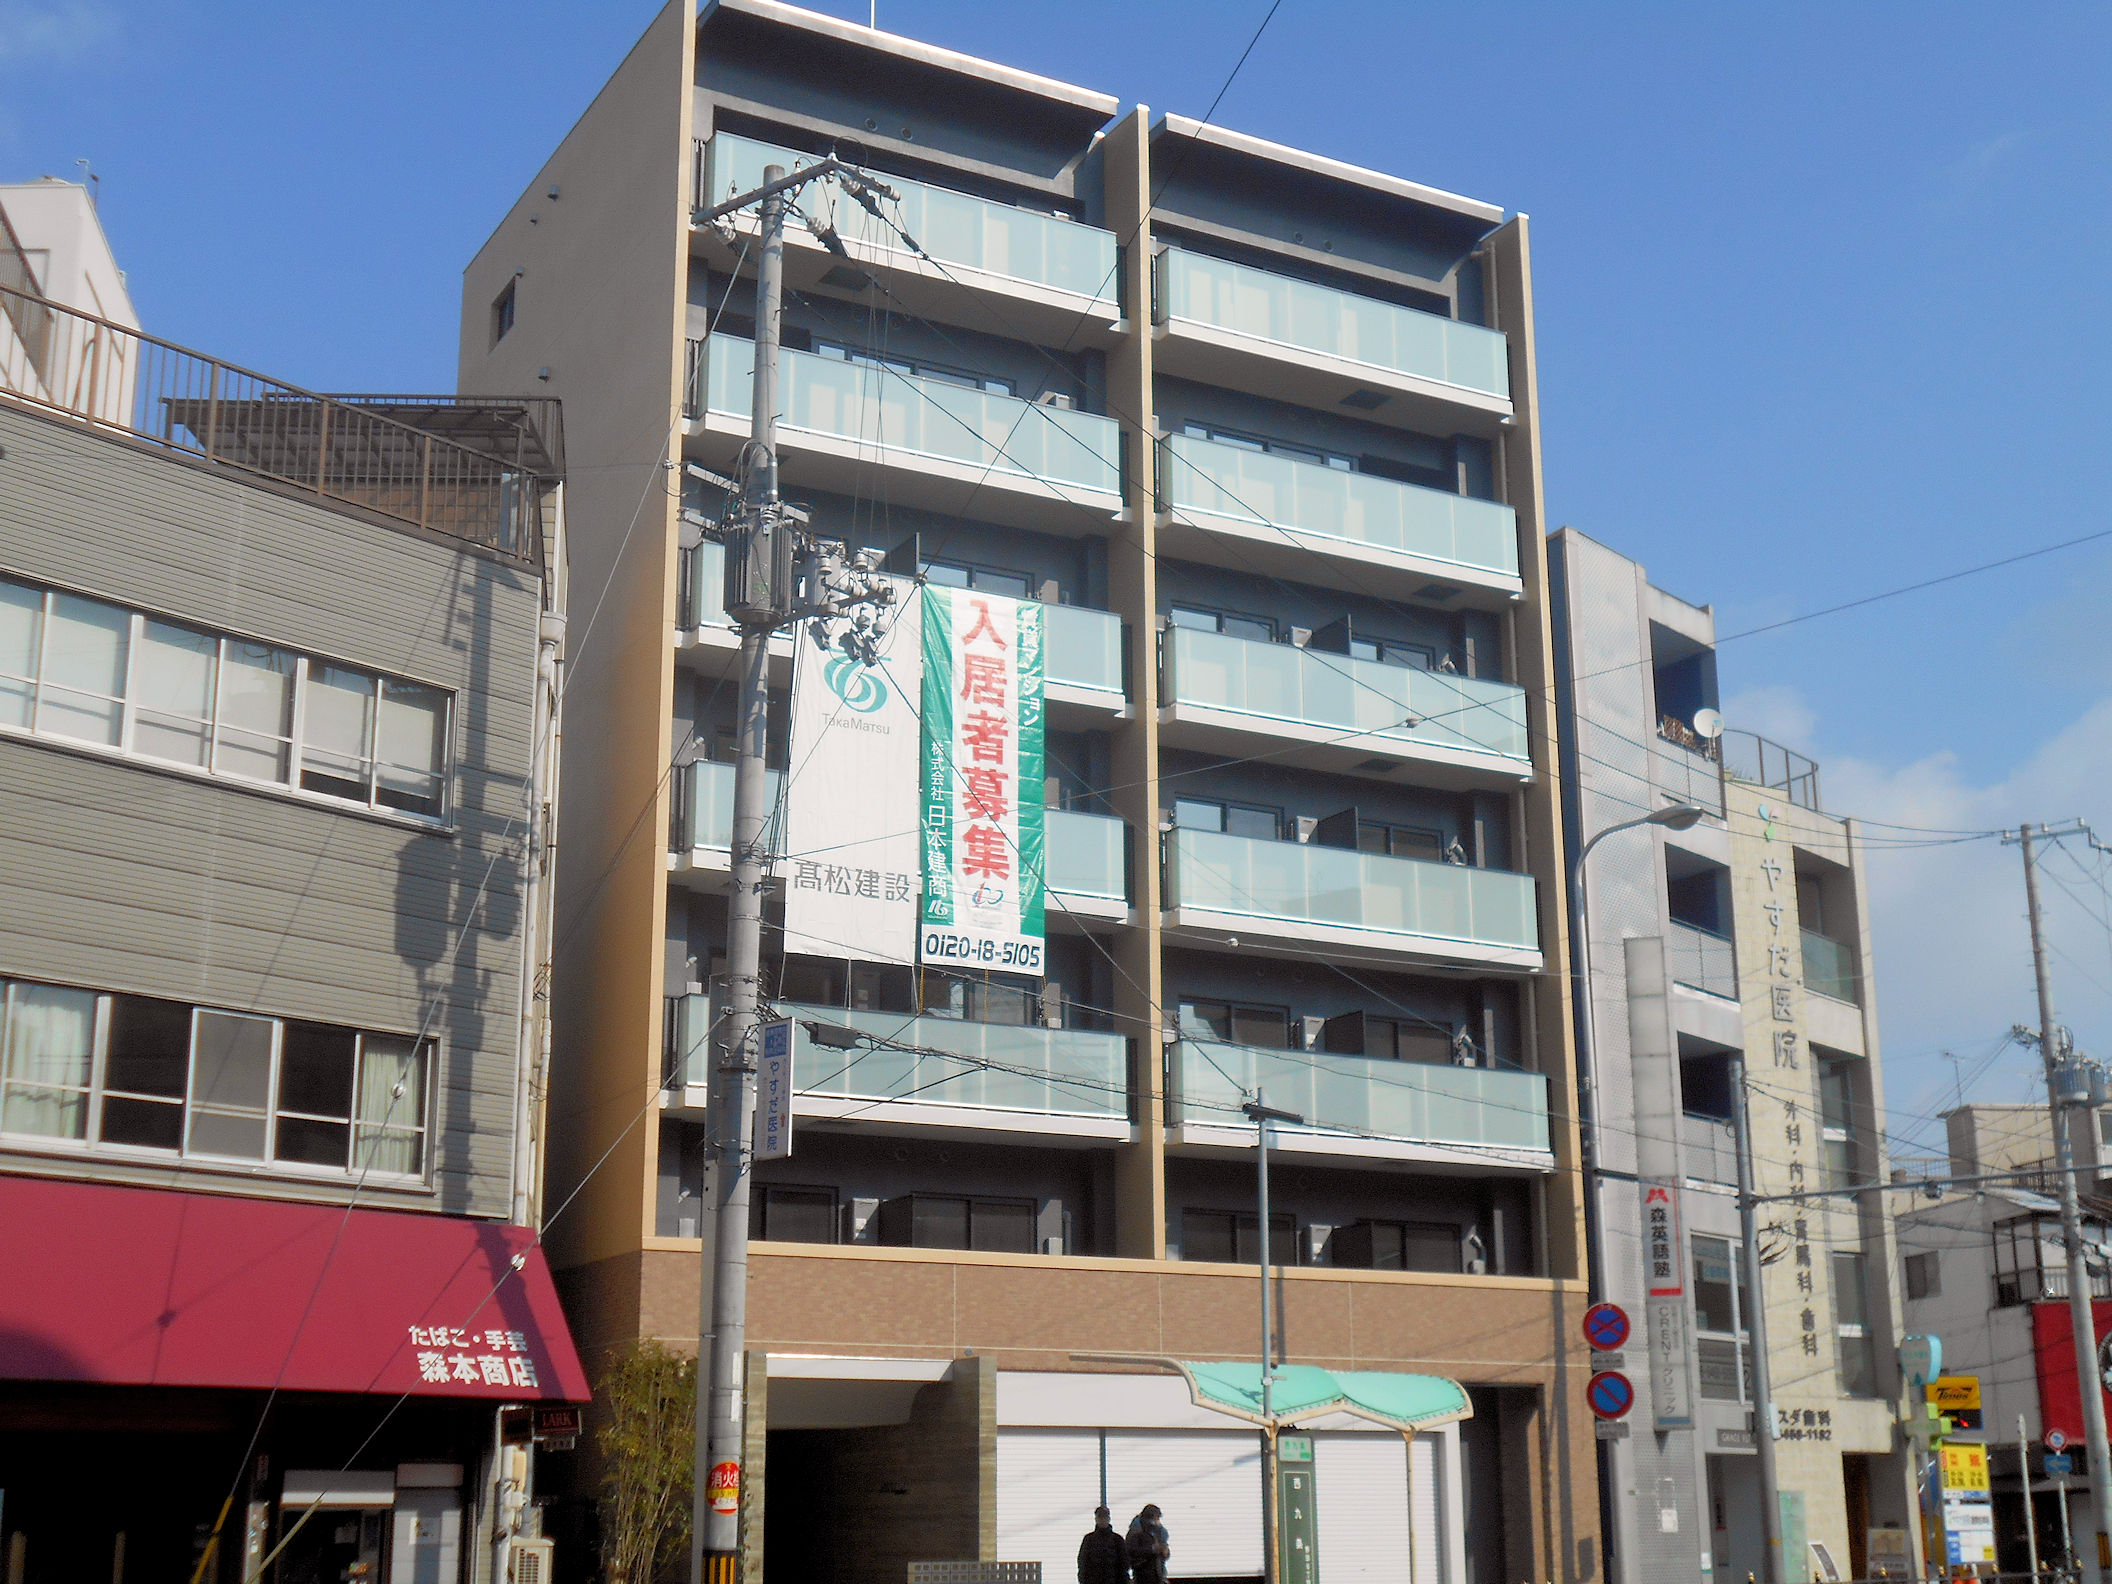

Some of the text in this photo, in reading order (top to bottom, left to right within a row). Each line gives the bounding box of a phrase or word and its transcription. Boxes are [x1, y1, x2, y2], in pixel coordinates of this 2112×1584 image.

[961, 598, 1010, 882] 入居者募集
[925, 932, 1041, 970] 0120-18-5105
[1760, 857, 1799, 1070] やすだ医院
[767, 1060, 779, 1151] やすだ医院
[1650, 1207, 1671, 1279] 森英語塾
[408, 1324, 529, 1353] たばこ・手芸
[417, 1351, 540, 1388] 森本商店
